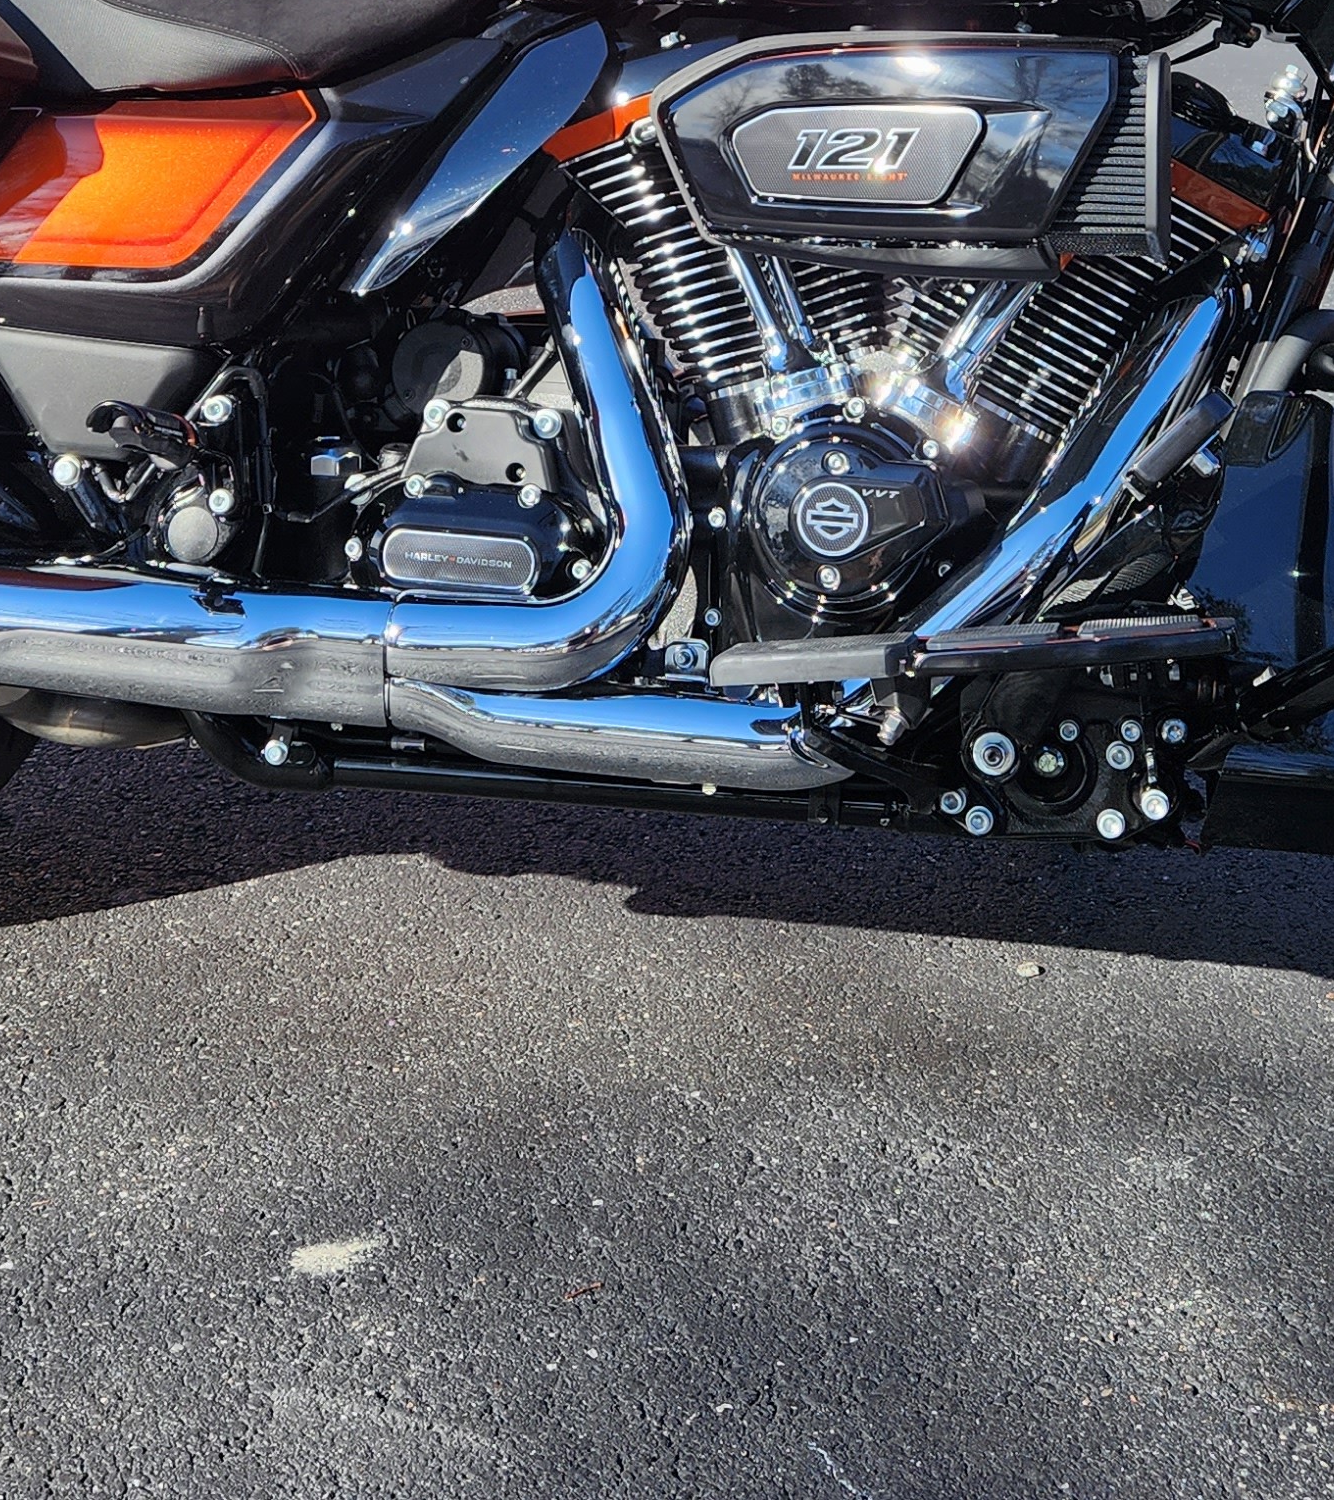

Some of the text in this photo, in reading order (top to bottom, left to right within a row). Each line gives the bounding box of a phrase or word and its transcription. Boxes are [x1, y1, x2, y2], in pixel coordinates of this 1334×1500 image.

[787, 127, 921, 170] 121
[791, 171, 861, 181] MILWAUKEE
[861, 488, 900, 499] VVT
[405, 551, 512, 569] HARLEY-DAVIDSON
